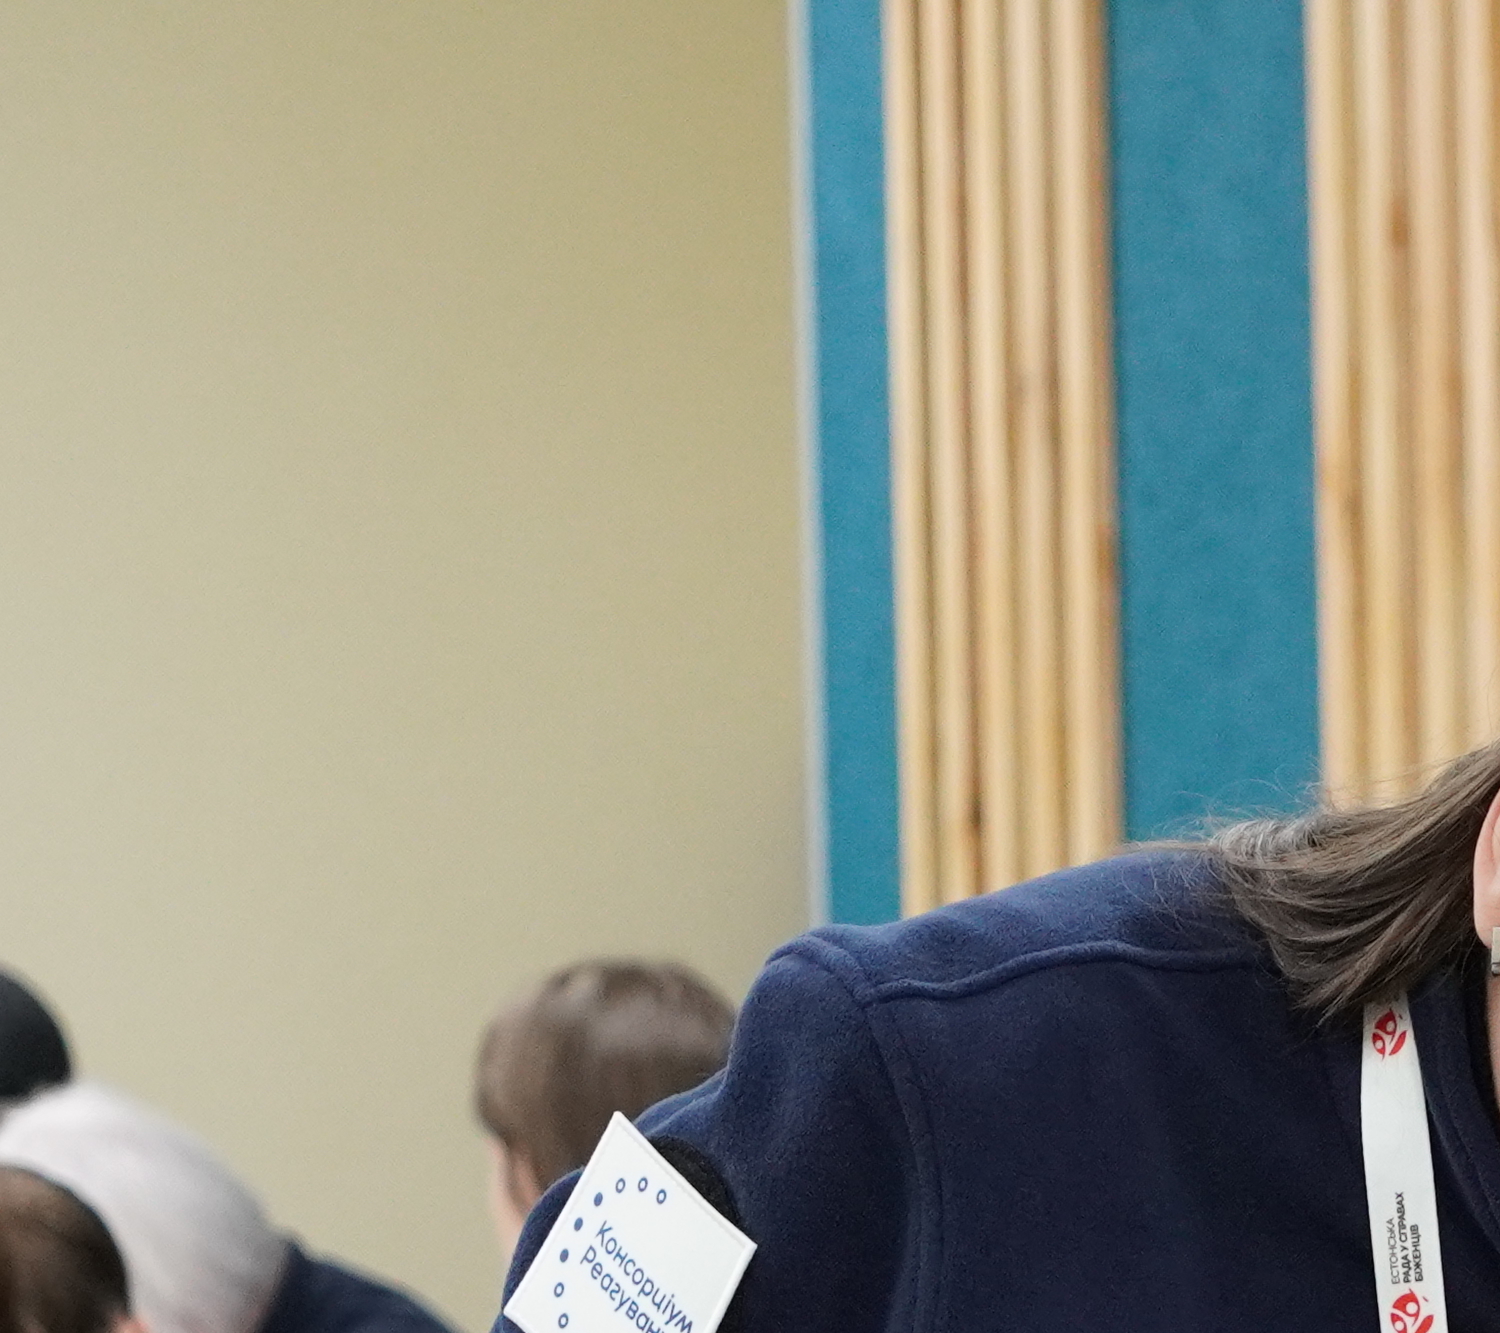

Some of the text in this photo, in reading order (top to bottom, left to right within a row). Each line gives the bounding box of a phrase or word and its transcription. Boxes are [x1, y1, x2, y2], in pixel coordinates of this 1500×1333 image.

[1386, 1217, 1400, 1284] ЕСТОНСЬКА
[1400, 1245, 1409, 1253] У
[1401, 1254, 1412, 1283] РАДА
